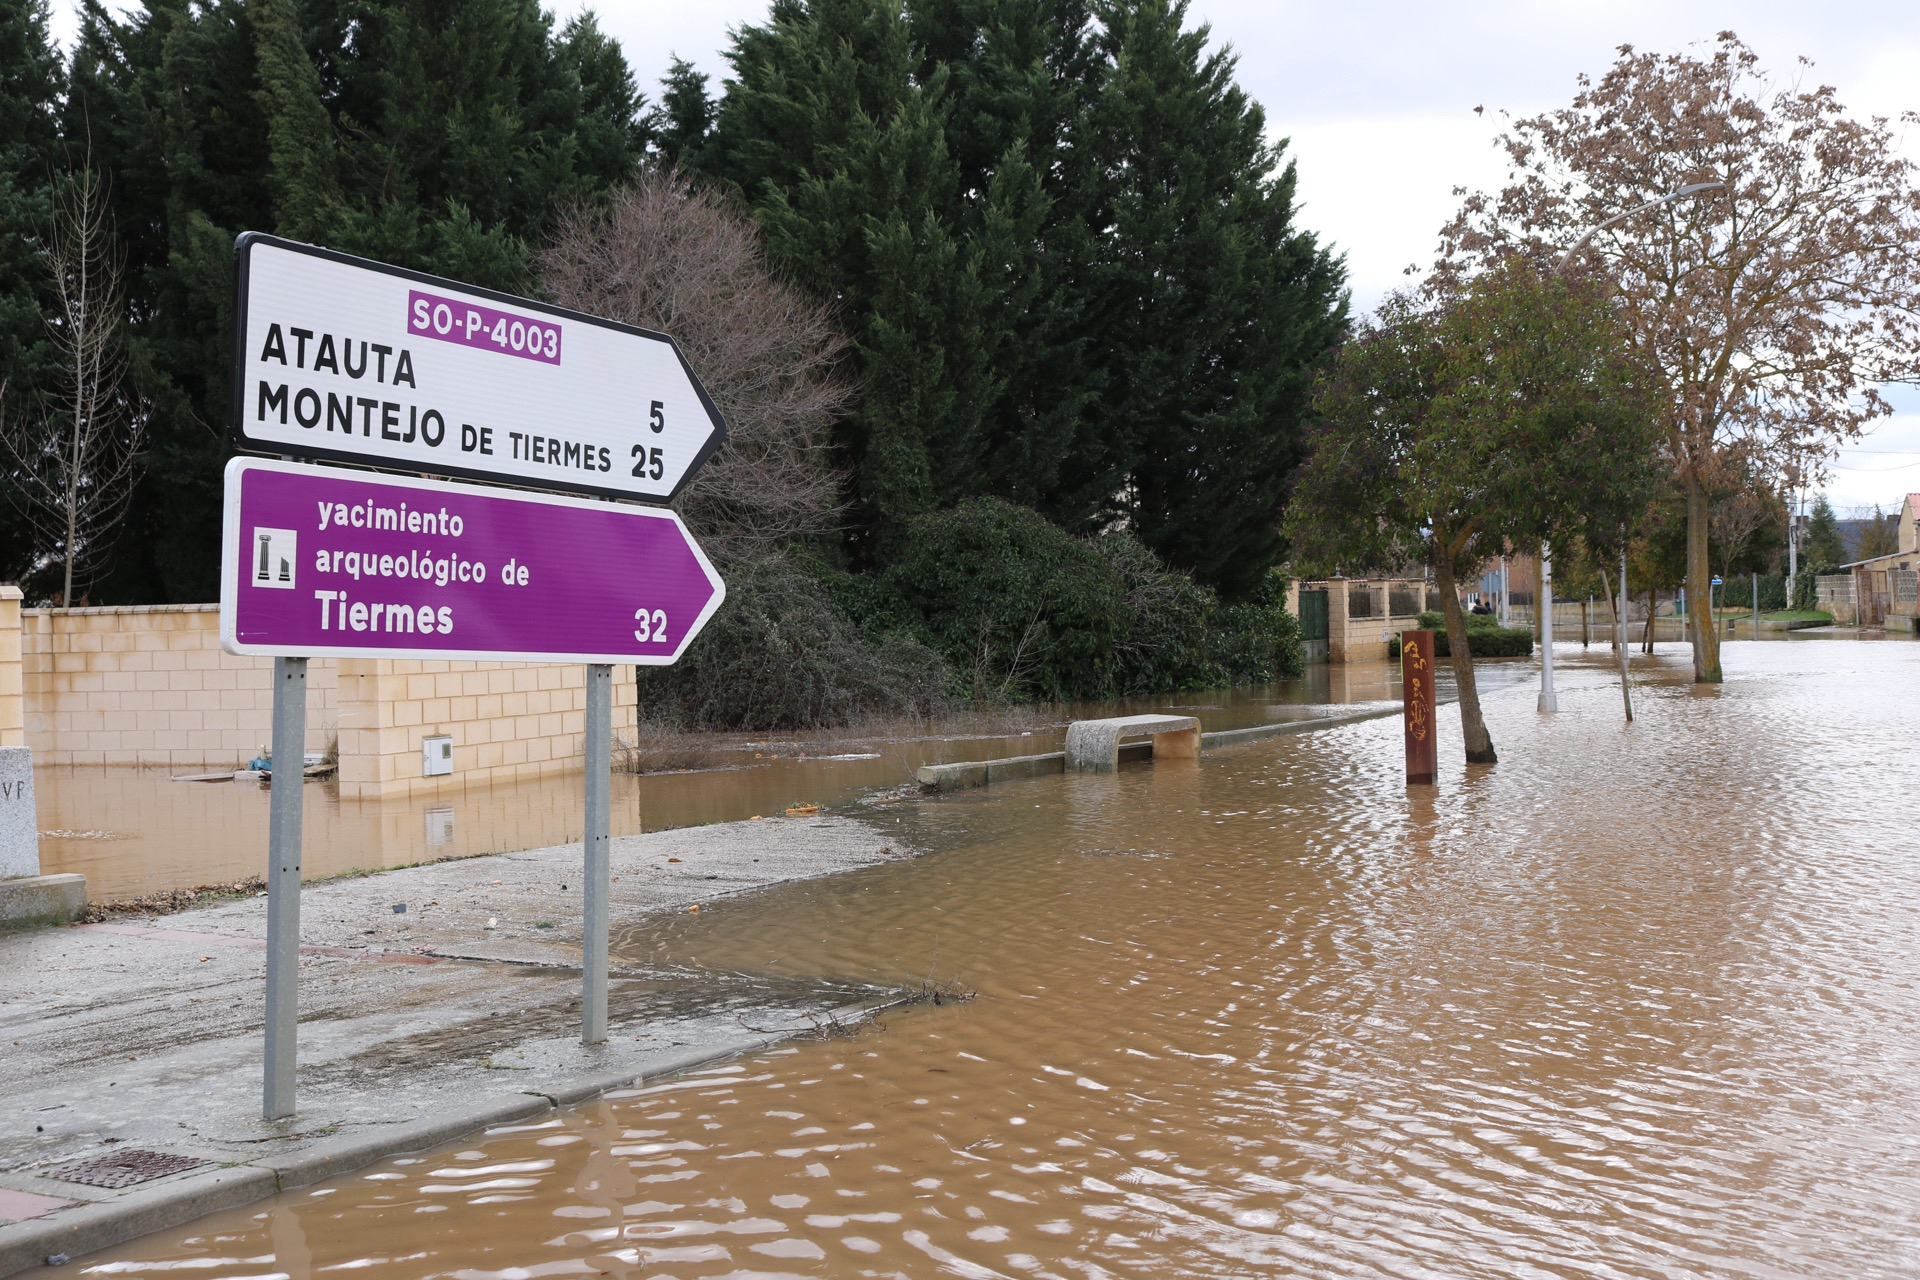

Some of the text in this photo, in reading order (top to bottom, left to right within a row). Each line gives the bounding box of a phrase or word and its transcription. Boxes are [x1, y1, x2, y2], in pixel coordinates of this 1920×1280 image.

[412, 298, 558, 359] SO-P-4003
[260, 322, 665, 434] ATAUTA 5
[257, 380, 664, 481] MONTEJO DE TIERMES 25
[317, 498, 464, 538] yacimiento
[315, 549, 530, 587] arqueológico de
[314, 589, 668, 643] Tiermes 32
